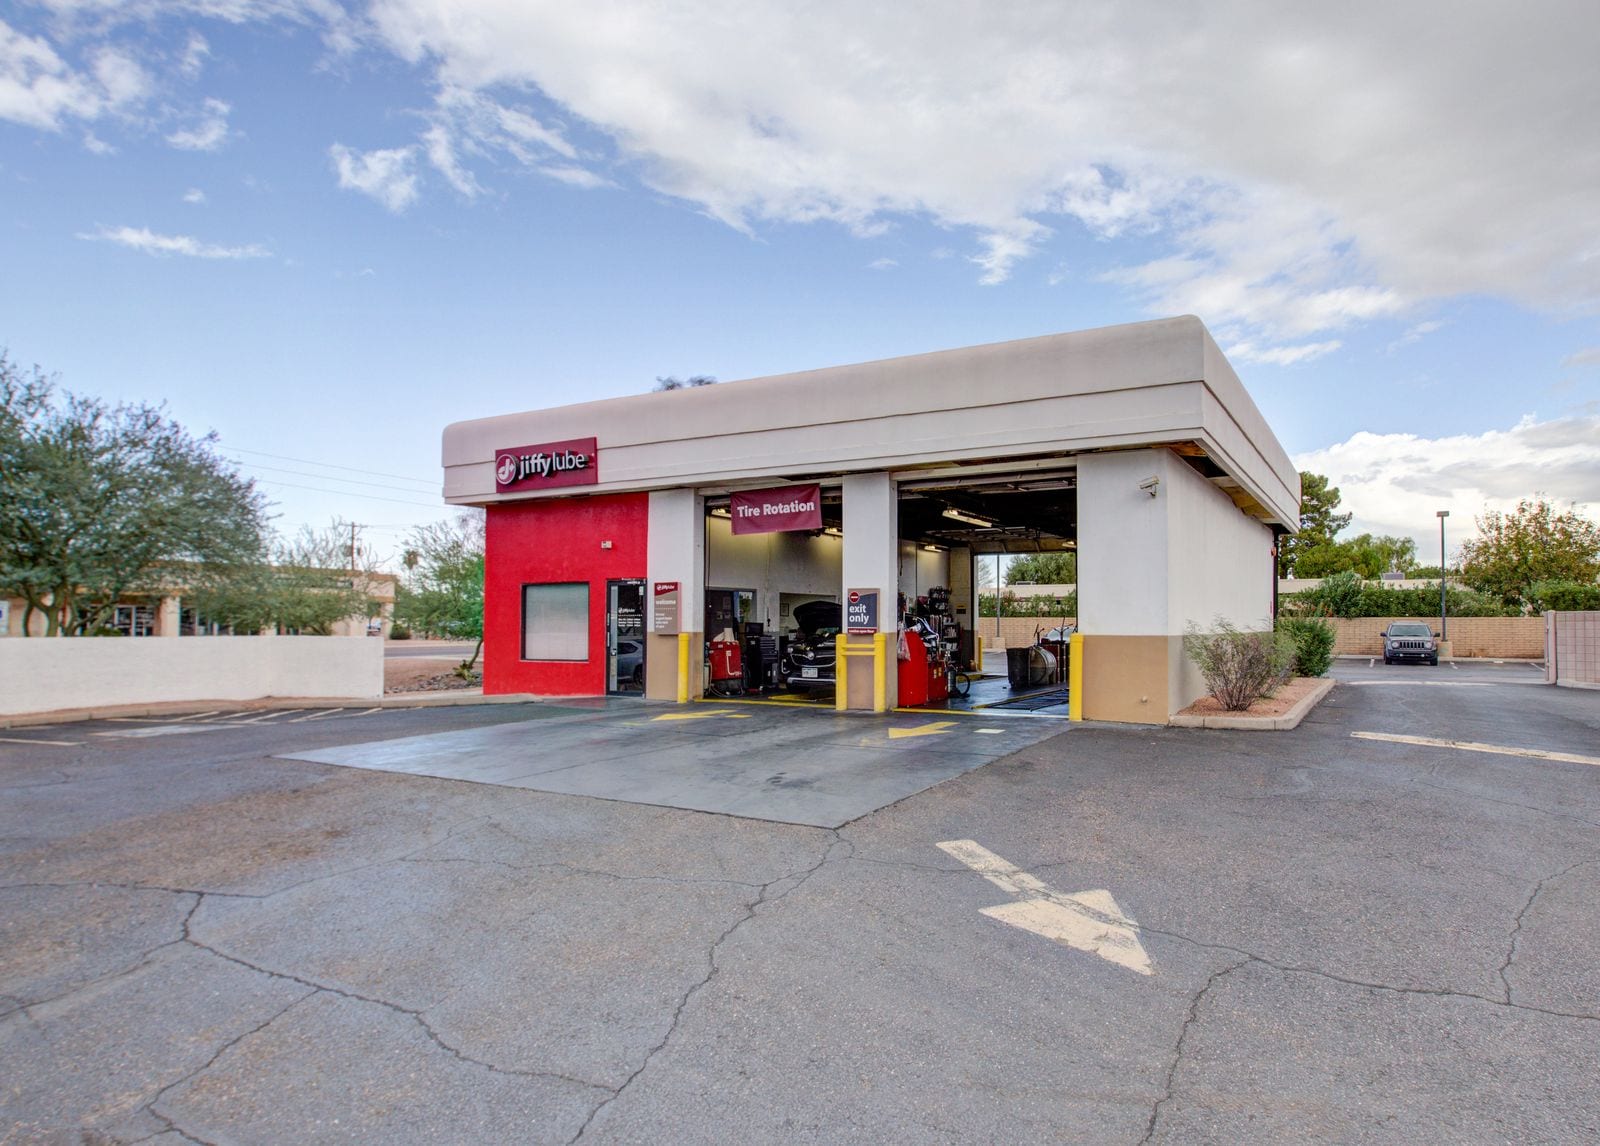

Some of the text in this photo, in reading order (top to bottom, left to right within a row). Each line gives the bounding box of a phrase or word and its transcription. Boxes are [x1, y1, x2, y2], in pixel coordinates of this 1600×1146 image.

[736, 500, 815, 518] Tire Rotation
[849, 603, 867, 613] exit
[849, 613, 870, 625] only
